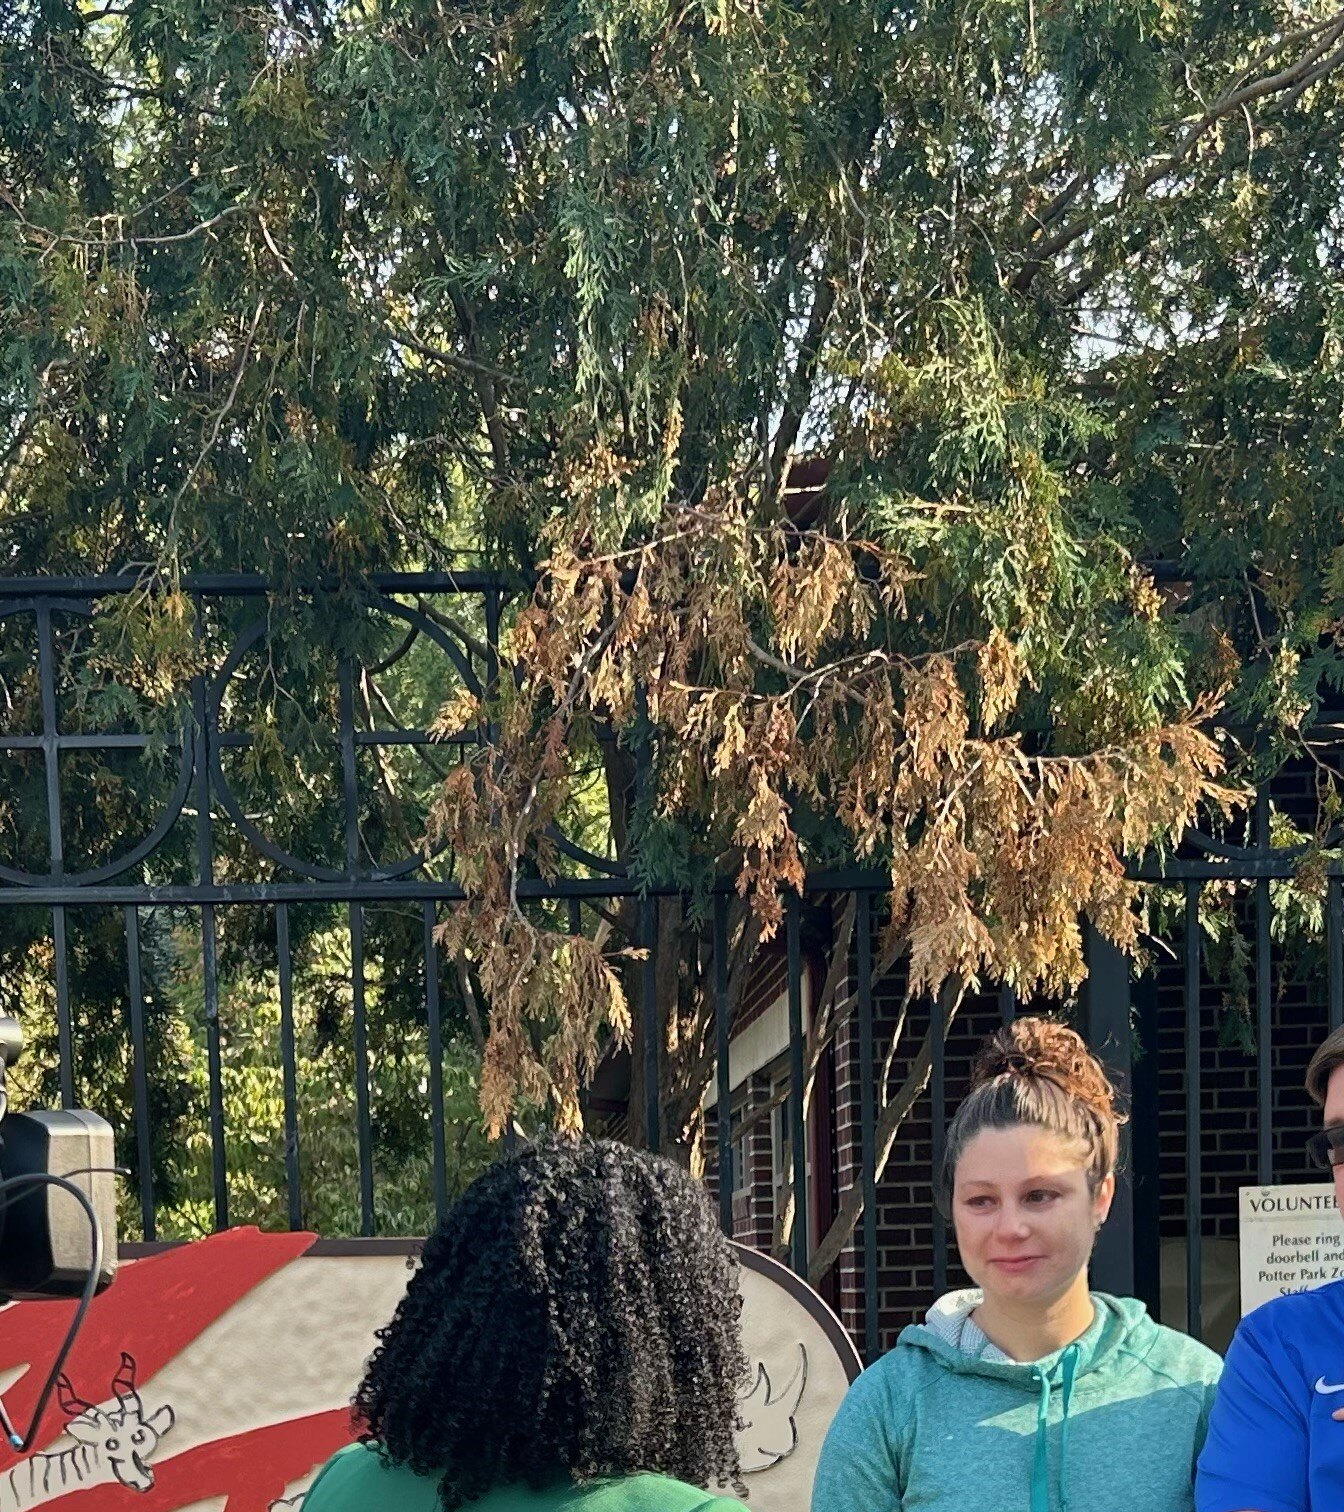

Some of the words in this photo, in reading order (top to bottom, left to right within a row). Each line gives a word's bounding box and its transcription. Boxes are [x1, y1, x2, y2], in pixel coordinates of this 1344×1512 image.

[1249, 1194, 1340, 1213] VOLUNTEE
[1272, 1233, 1312, 1247] Please
[1316, 1232, 1341, 1247] ring
[1266, 1249, 1319, 1264] doorbell
[1258, 1270, 1296, 1283] Potter
[1300, 1266, 1327, 1280] Park
